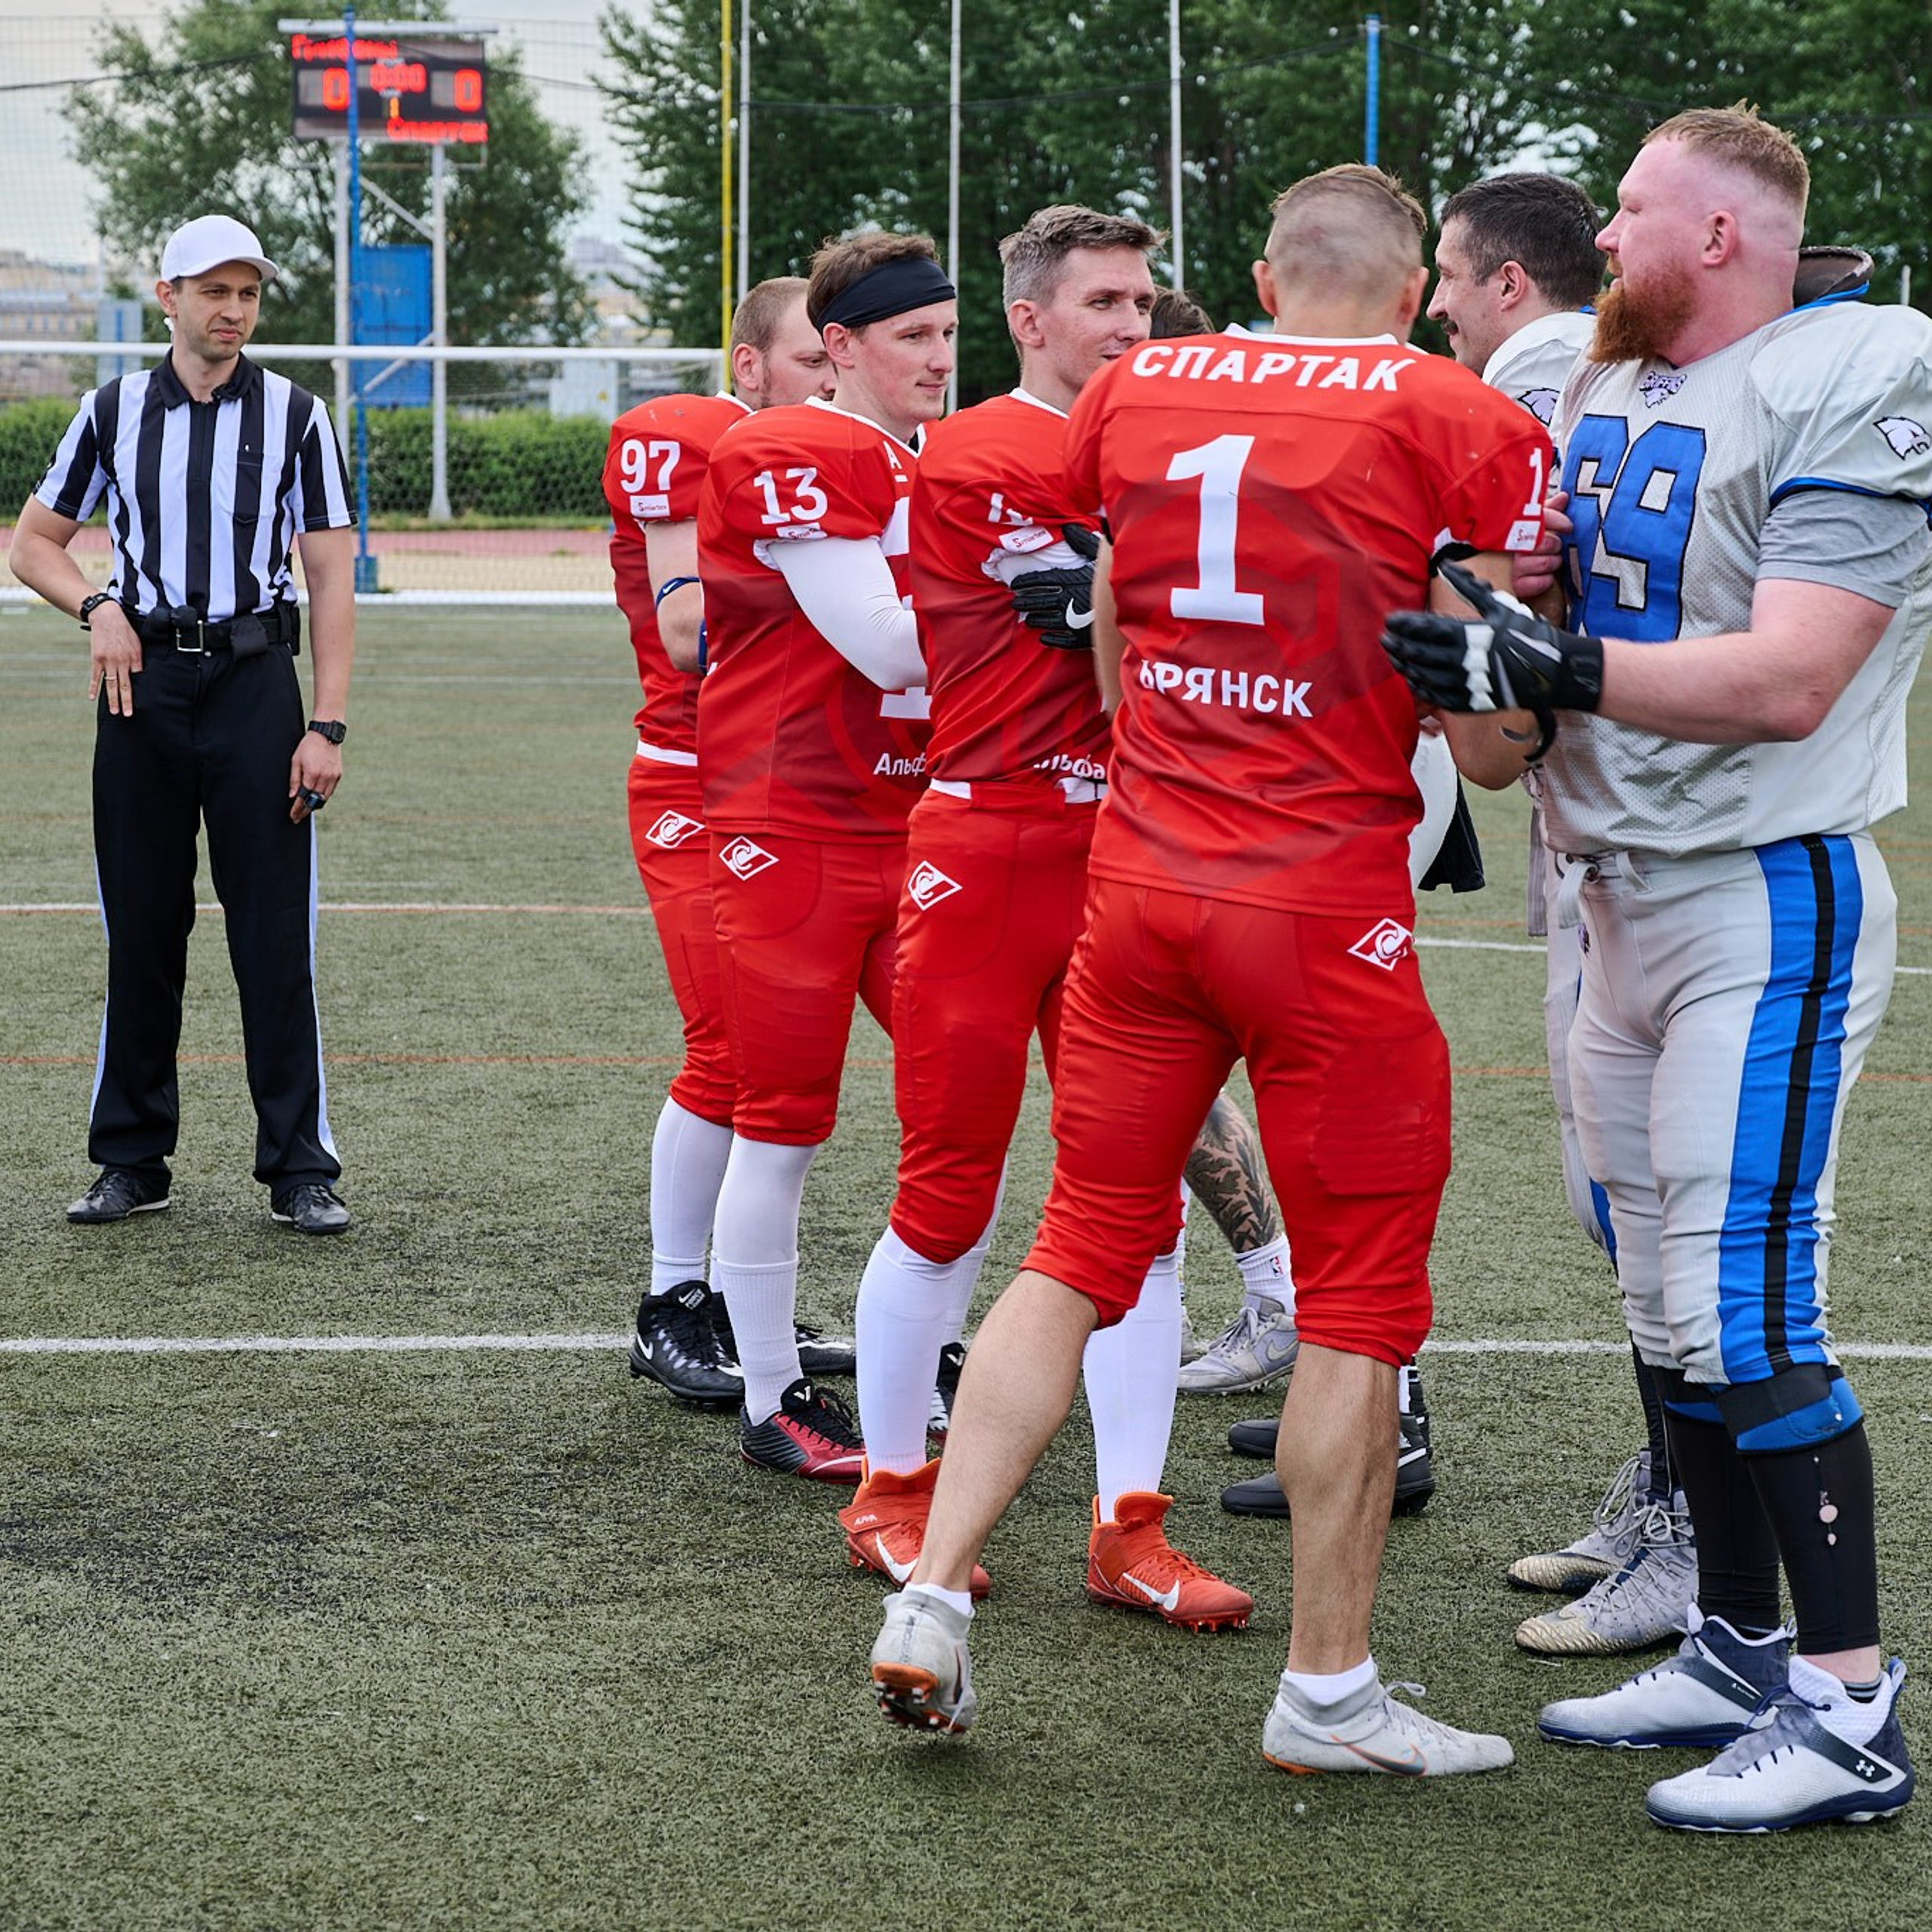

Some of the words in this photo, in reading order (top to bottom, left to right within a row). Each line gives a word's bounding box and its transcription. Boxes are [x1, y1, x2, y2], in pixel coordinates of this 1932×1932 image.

[323, 68, 349, 110] 0
[454, 69, 481, 112] 0
[1132, 345, 1417, 392] СПАРТАК
[620, 439, 680, 493] 97
[754, 468, 828, 525] 13
[1165, 434, 1265, 626] 1
[1561, 413, 1706, 643] 69
[873, 752, 927, 777] Альф
